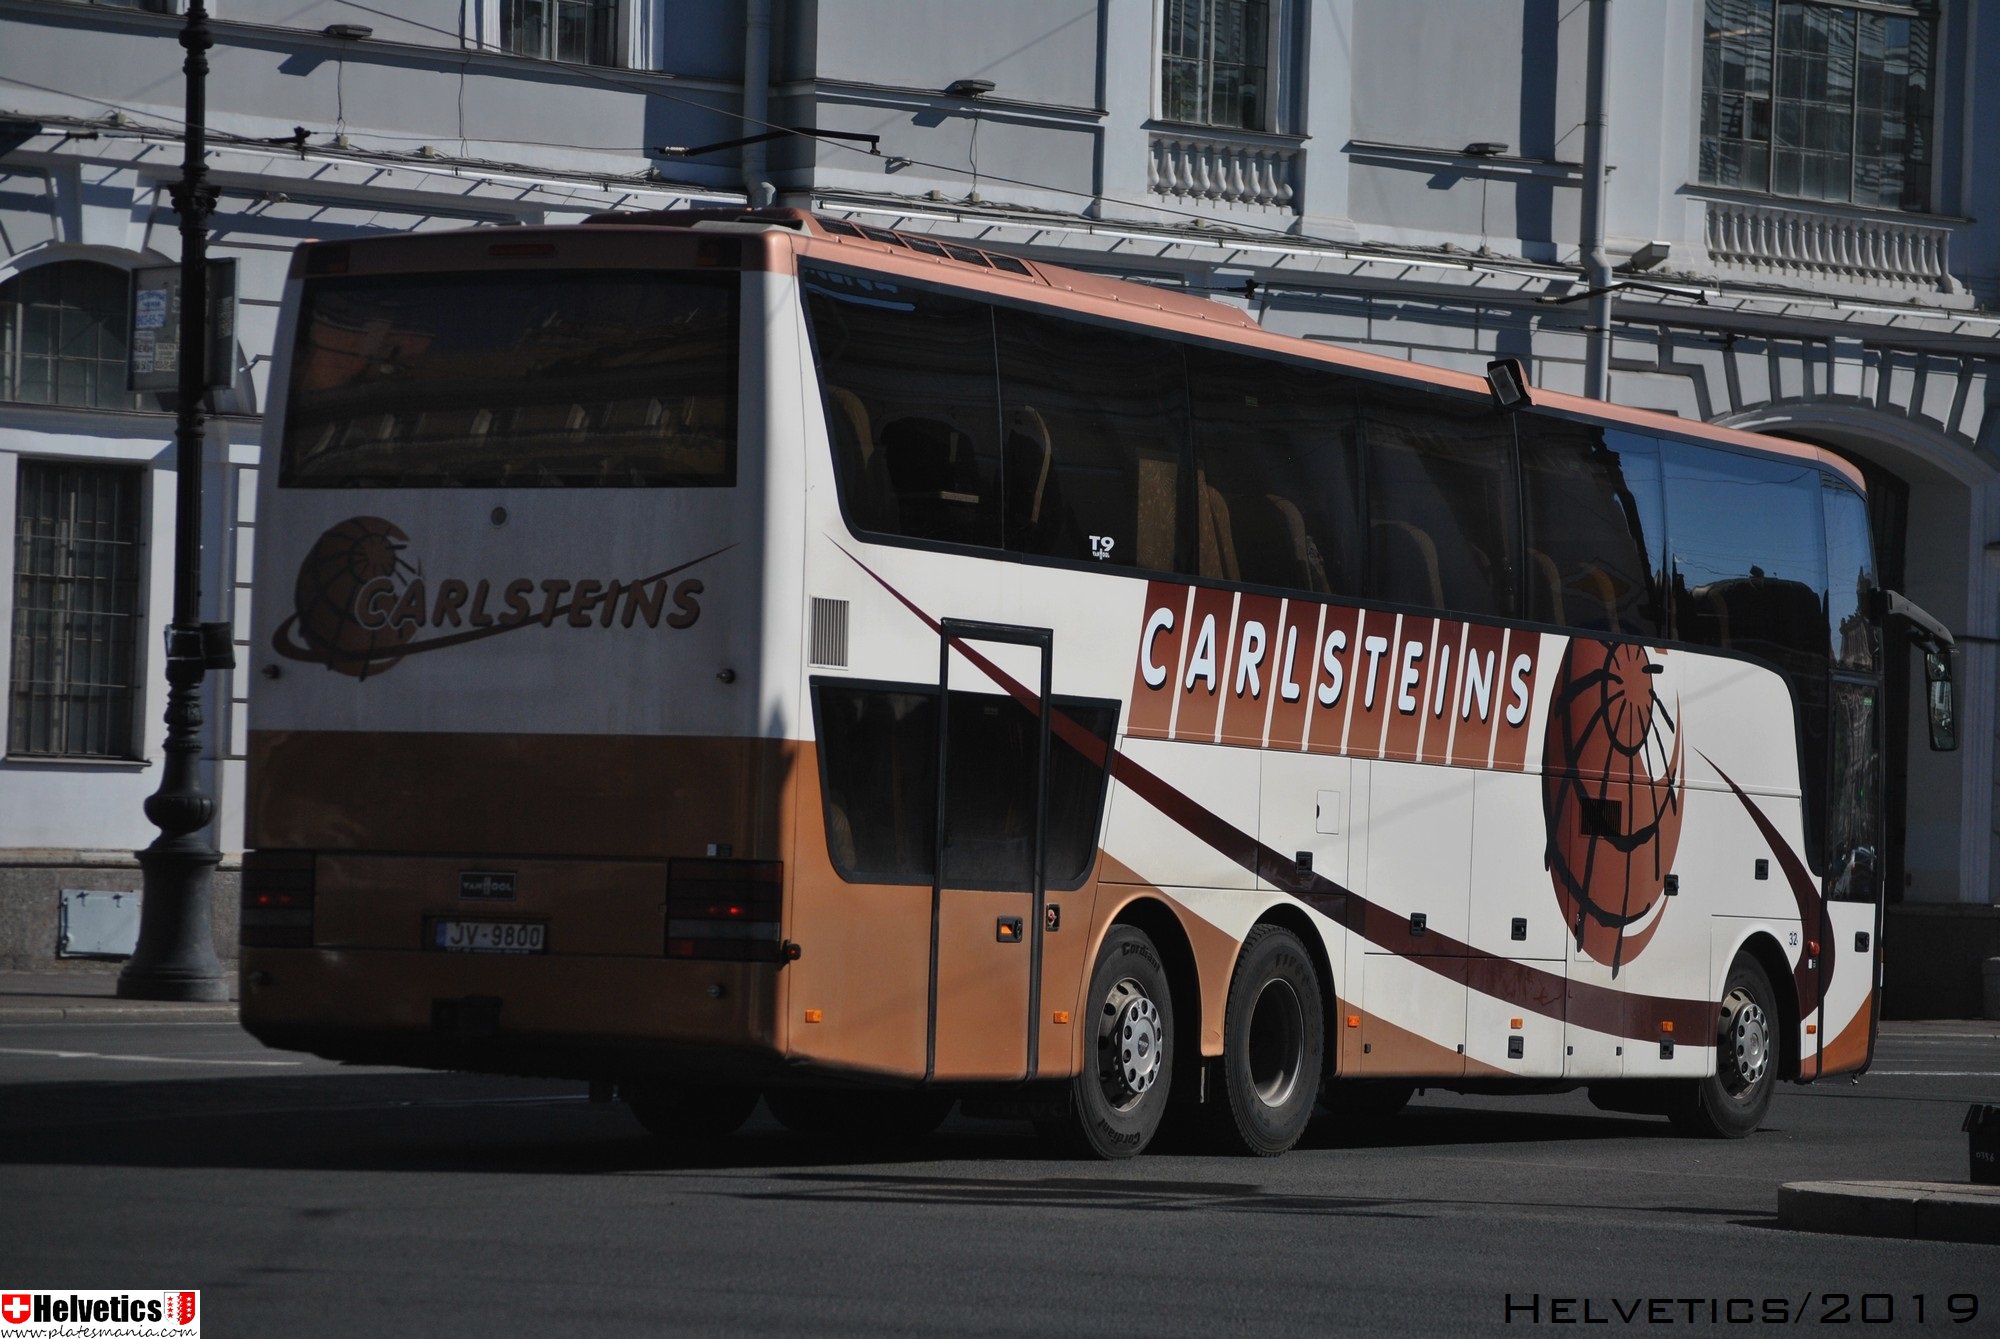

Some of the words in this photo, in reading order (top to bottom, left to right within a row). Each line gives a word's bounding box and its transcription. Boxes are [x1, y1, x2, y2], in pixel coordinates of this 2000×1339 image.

[1089, 535, 1114, 552] T9
[356, 577, 705, 629] CARLSTEINS
[1140, 607, 1532, 726] CARLSTEINS
[1788, 932, 1798, 946] 32
